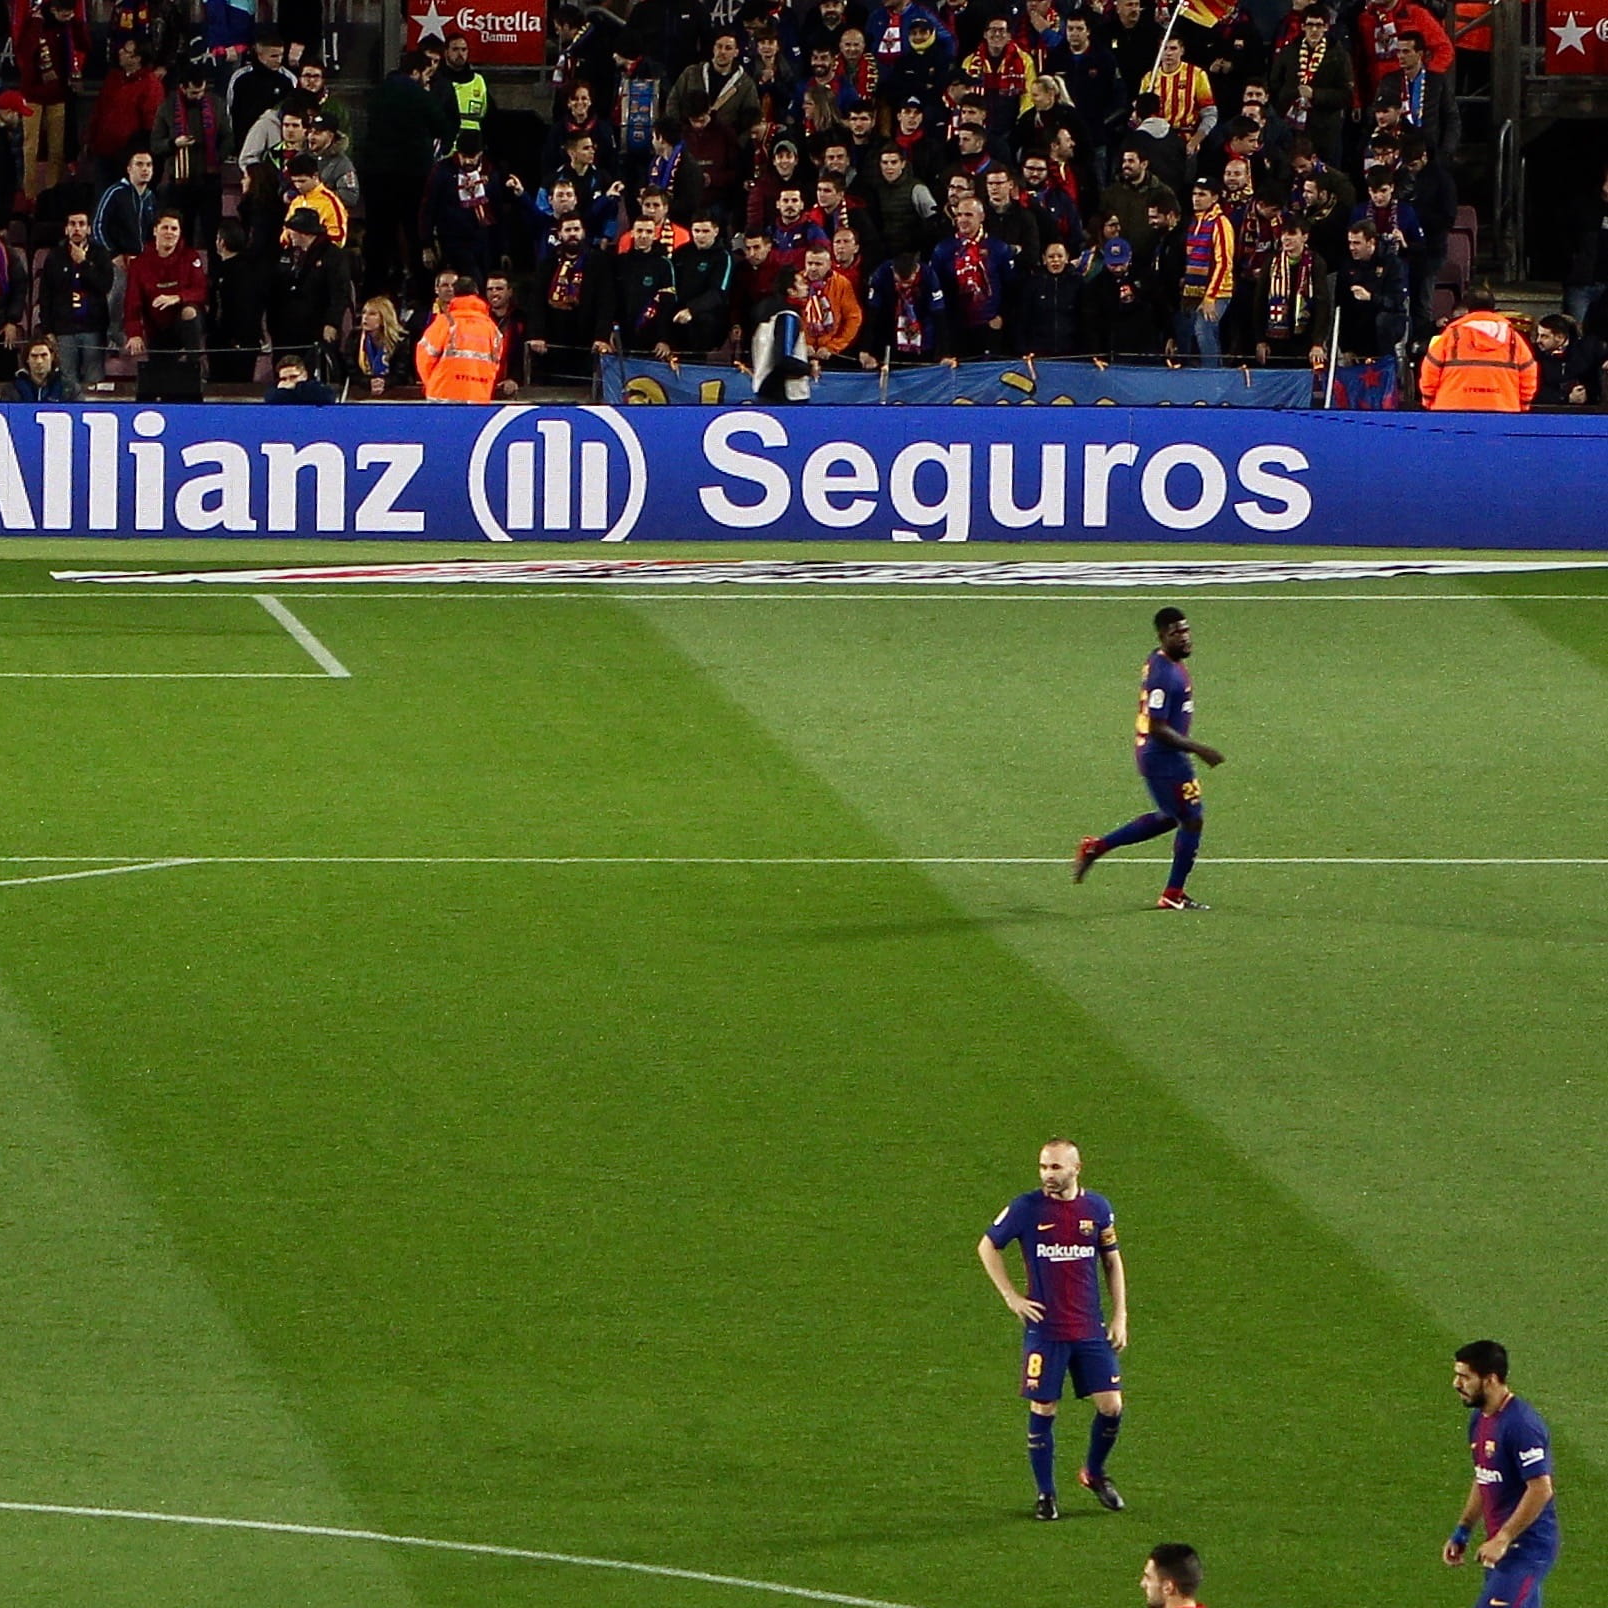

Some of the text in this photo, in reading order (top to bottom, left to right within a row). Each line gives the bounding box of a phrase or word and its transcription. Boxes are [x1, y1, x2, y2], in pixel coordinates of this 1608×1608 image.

[456, 7, 542, 31] Estrella
[481, 31, 518, 43] Damm
[698, 411, 1313, 542] Seguros
[1036, 1244, 1095, 1258] Rakuten
[1027, 1353, 1043, 1378] 8
